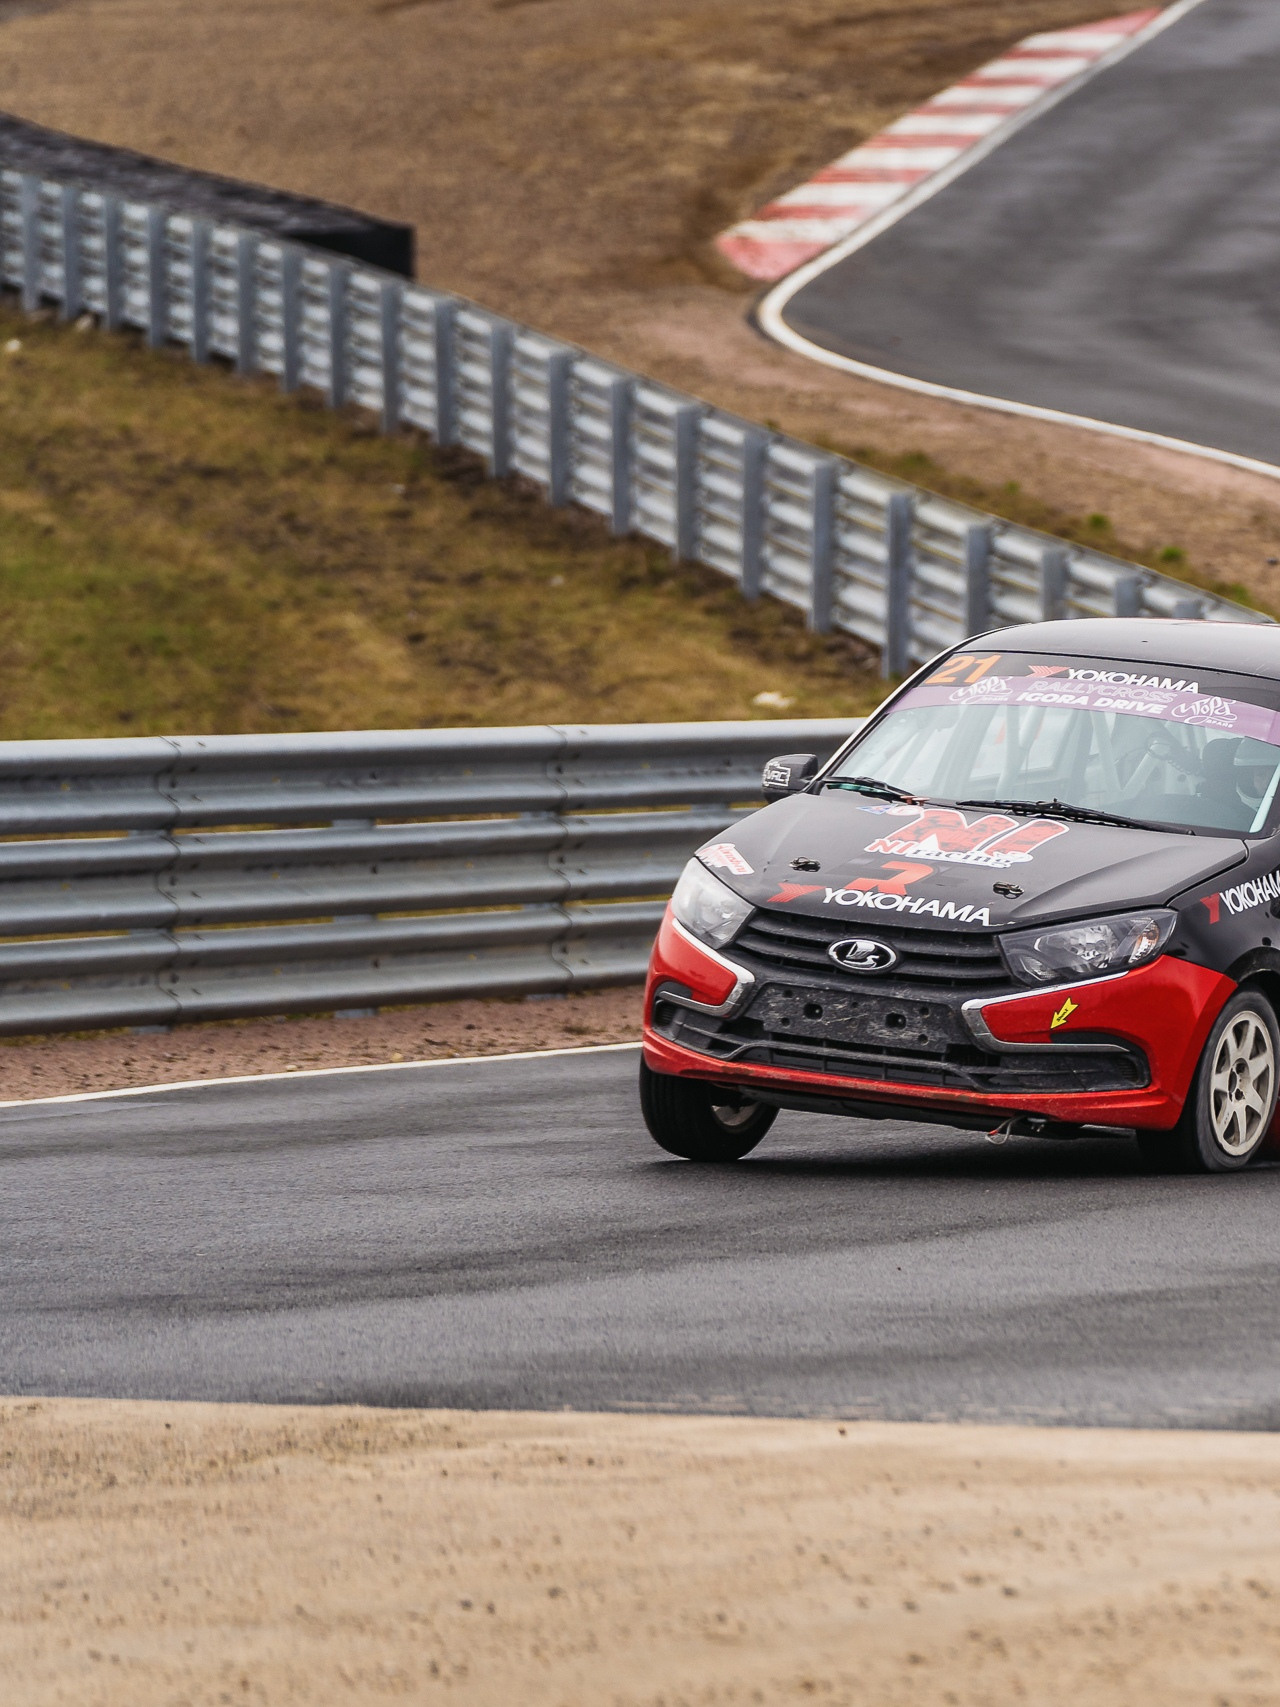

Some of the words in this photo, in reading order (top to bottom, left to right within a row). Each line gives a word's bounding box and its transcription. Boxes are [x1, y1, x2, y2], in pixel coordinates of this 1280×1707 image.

[925, 654, 1001, 684] 21
[1067, 668, 1199, 694] YOKOHAMA
[1015, 692, 1089, 706] IGORA
[1093, 697, 1168, 715] DRIVE
[1028, 680, 1178, 704] RALLYCROSS
[821, 887, 991, 927] YOKOHAMA
